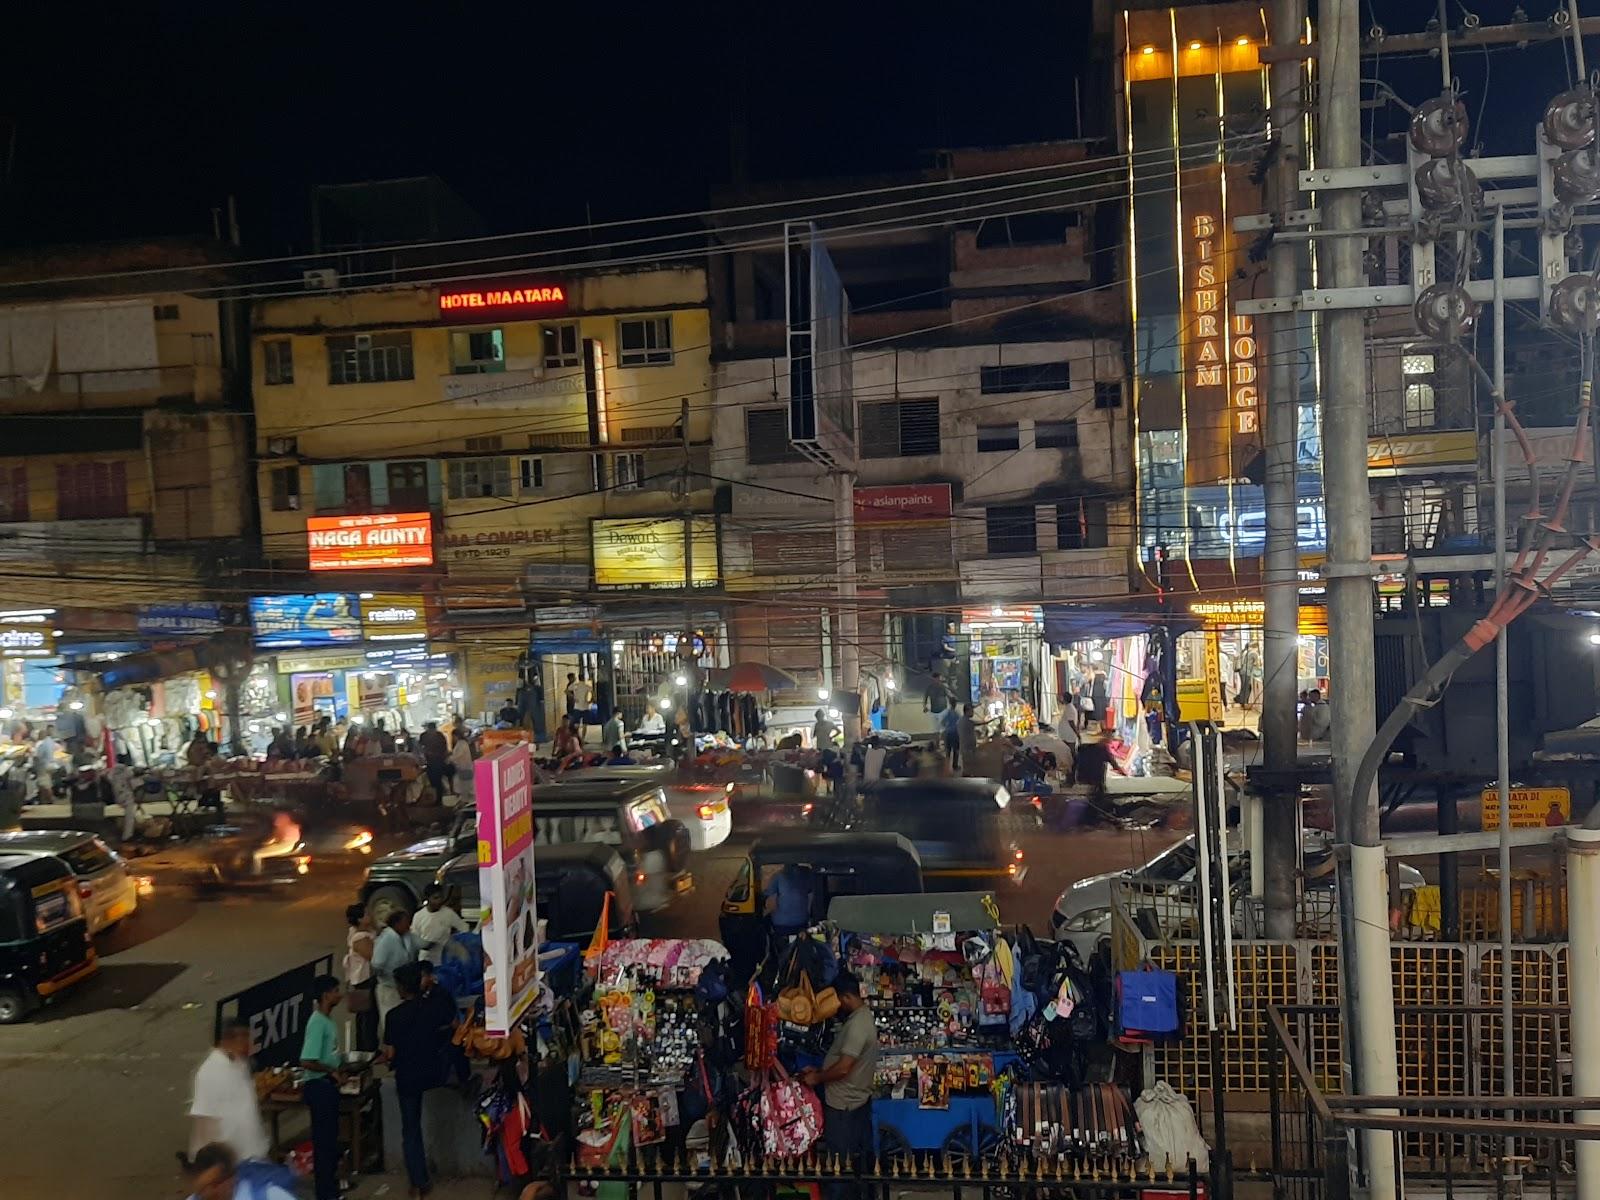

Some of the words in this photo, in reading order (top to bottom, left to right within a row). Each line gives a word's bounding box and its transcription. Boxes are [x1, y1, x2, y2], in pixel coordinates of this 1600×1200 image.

[440, 293, 486, 309] HOTEL
[1194, 215, 1222, 387] BISHRAM
[1233, 315, 1259, 434] LODGE
[872, 495, 934, 507] asianpaints
[310, 529, 362, 547] NAGA
[366, 527, 427, 545] AUNTY
[476, 529, 552, 545] COMPLEX
[368, 607, 416, 621] realme
[1206, 638, 1219, 712] PHARMACY
[1508, 792, 1528, 800] ATA
[248, 992, 304, 1057] EXIT
